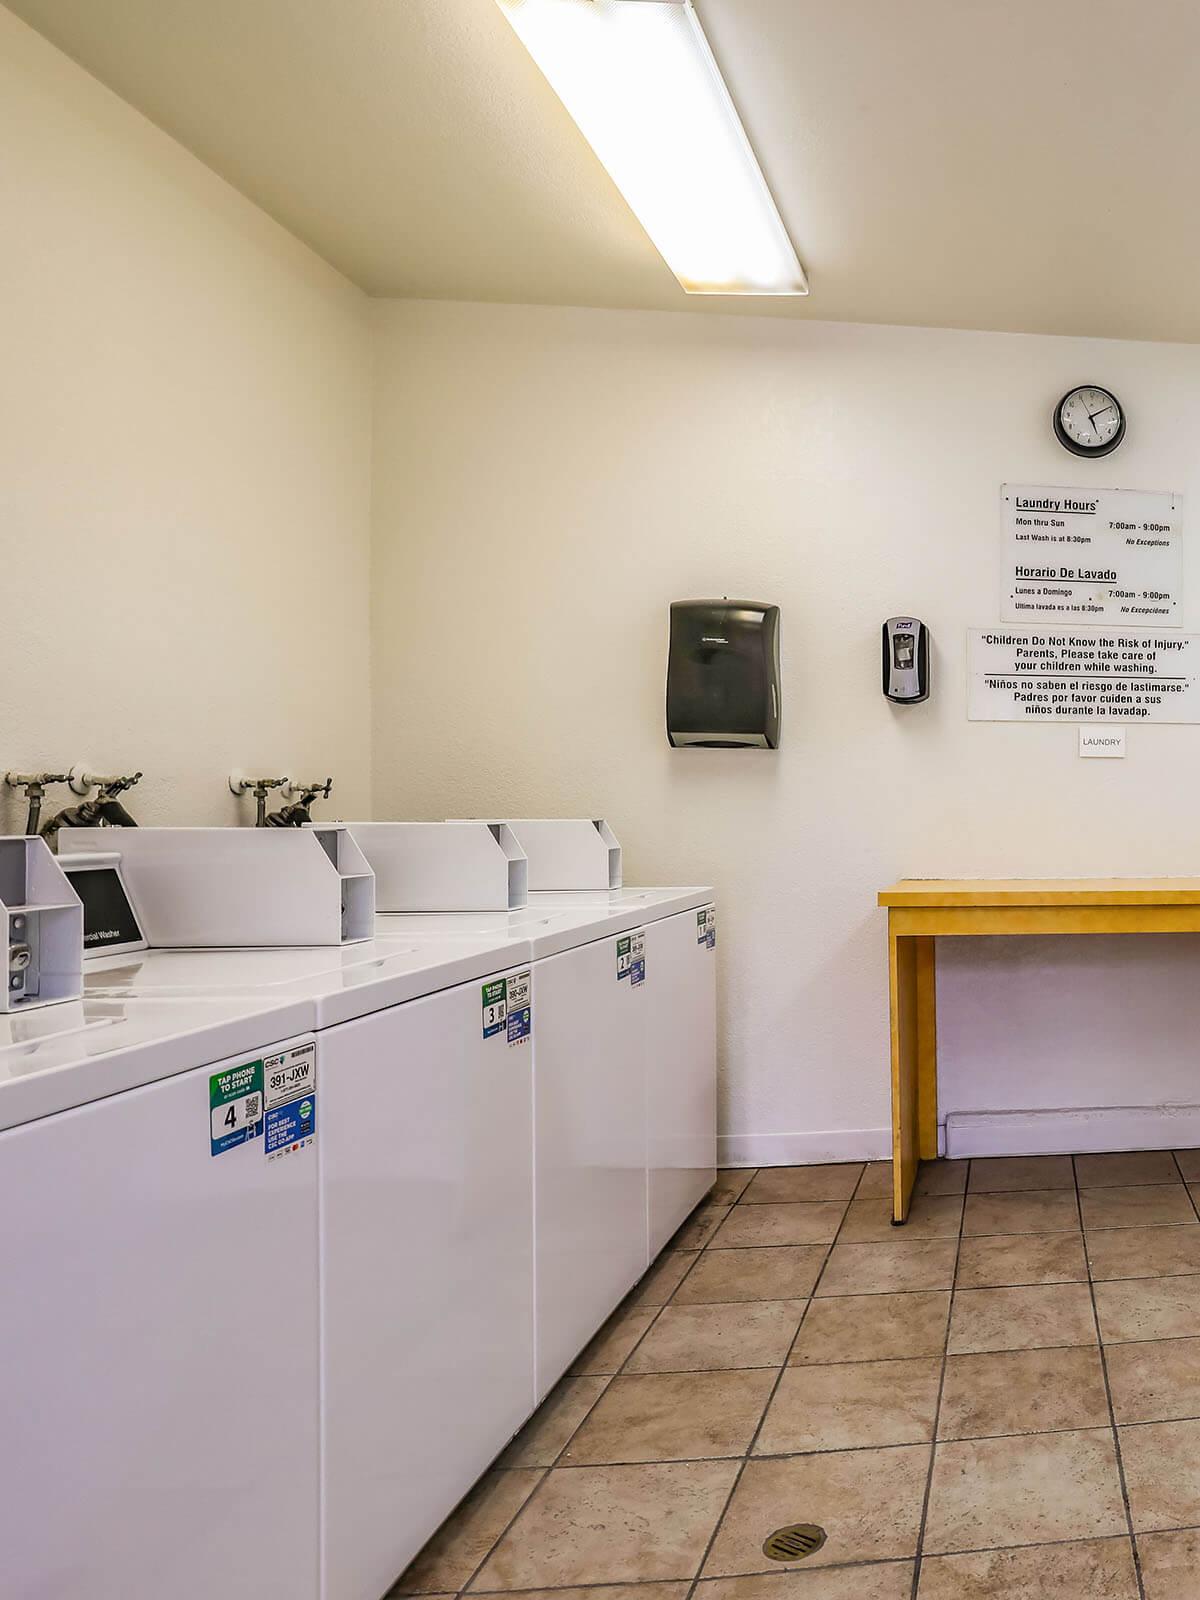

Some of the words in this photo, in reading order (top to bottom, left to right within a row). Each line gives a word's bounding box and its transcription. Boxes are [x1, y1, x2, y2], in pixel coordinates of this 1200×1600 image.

[1016, 497, 1060, 510] Laundry
[1064, 499, 1096, 511] Hours
[1143, 524, 1170, 532] 9:00pm
[1016, 566, 1056, 578] Horario
[1060, 568, 1074, 578] De
[1078, 568, 1117, 580] Lavado
[1043, 588, 1072, 597] Domingo
[1143, 592, 1170, 600] 9:00pm
[982, 635, 1028, 645] "Children
[1032, 637, 1045, 645] Do
[1049, 637, 1066, 646] Not
[1069, 637, 1096, 647] Know
[1100, 639, 1114, 647] the
[1118, 639, 1138, 648] Risk
[1142, 640, 1151, 648] of
[1155, 640, 1189, 650] Injury."
[1017, 648, 1057, 659] Parents,
[1061, 650, 1094, 659] Please
[1098, 651, 1118, 660] take
[1147, 652, 1156, 660] of
[1015, 662, 1037, 671] your
[1040, 661, 1081, 671] children
[1084, 663, 1110, 672] while
[1114, 664, 1157, 674] washing.
[985, 680, 1018, 689] "Niños
[1036, 681, 1066, 690] saben
[1070, 681, 1078, 690] el
[1082, 681, 1112, 692] riesgo
[1116, 682, 1128, 691] de
[1131, 683, 1189, 692] lastimarse."
[1014, 692, 1048, 701] Padres
[1052, 694, 1068, 703] por
[1072, 693, 1096, 702] favor
[1100, 694, 1132, 703] cuiden
[1026, 705, 1052, 714] niños
[1056, 706, 1093, 714] durante
[1097, 706, 1105, 714] la
[1109, 706, 1150, 717] lavadap.
[490, 1008, 494, 1023] 3
[218, 1075, 231, 1085] TAP
[232, 1066, 255, 1080] PHONE
[232, 1075, 252, 1089] START
[270, 1064, 309, 1088] 391-JXW
[224, 1105, 237, 1128] 4
